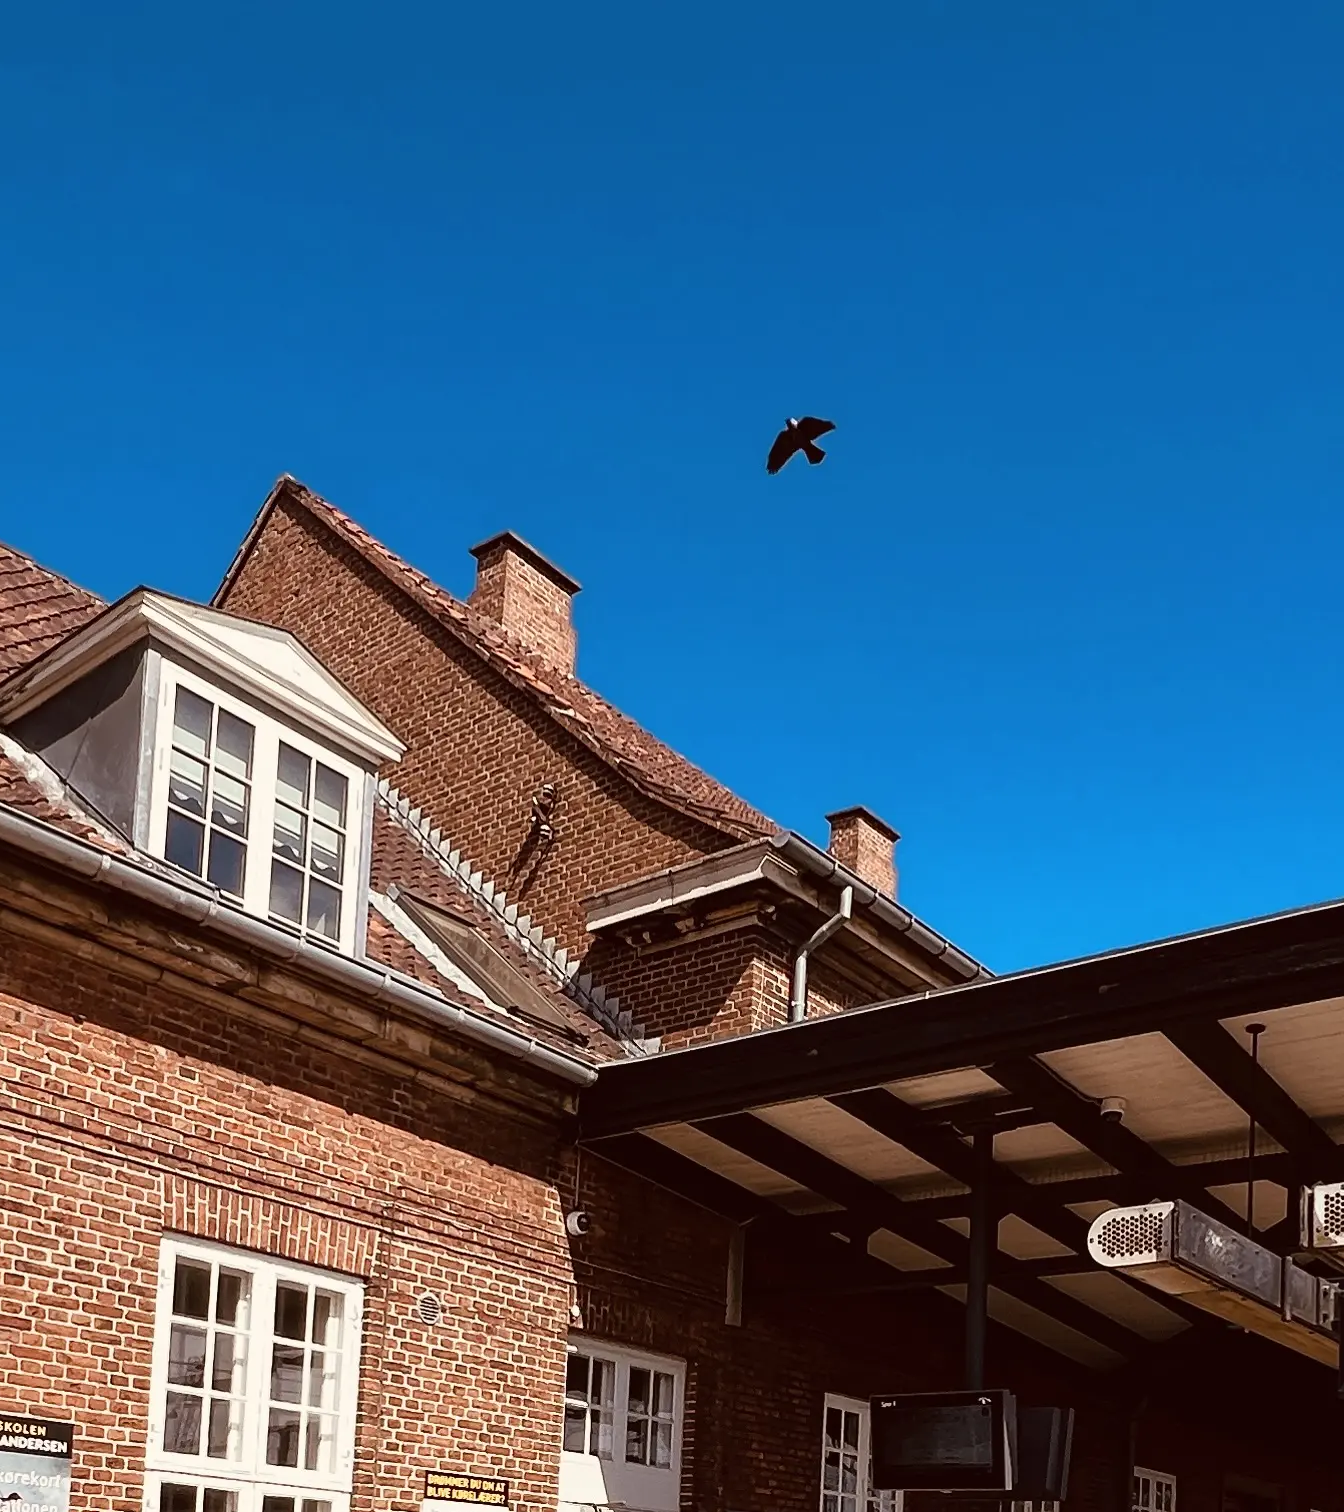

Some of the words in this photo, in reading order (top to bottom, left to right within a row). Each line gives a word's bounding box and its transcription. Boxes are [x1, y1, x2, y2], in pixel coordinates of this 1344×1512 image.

[426, 1486, 451, 1499] BLIVE
[470, 1478, 482, 1489] DU
[482, 1481, 494, 1491] OM
[495, 1483, 506, 1493] AT
